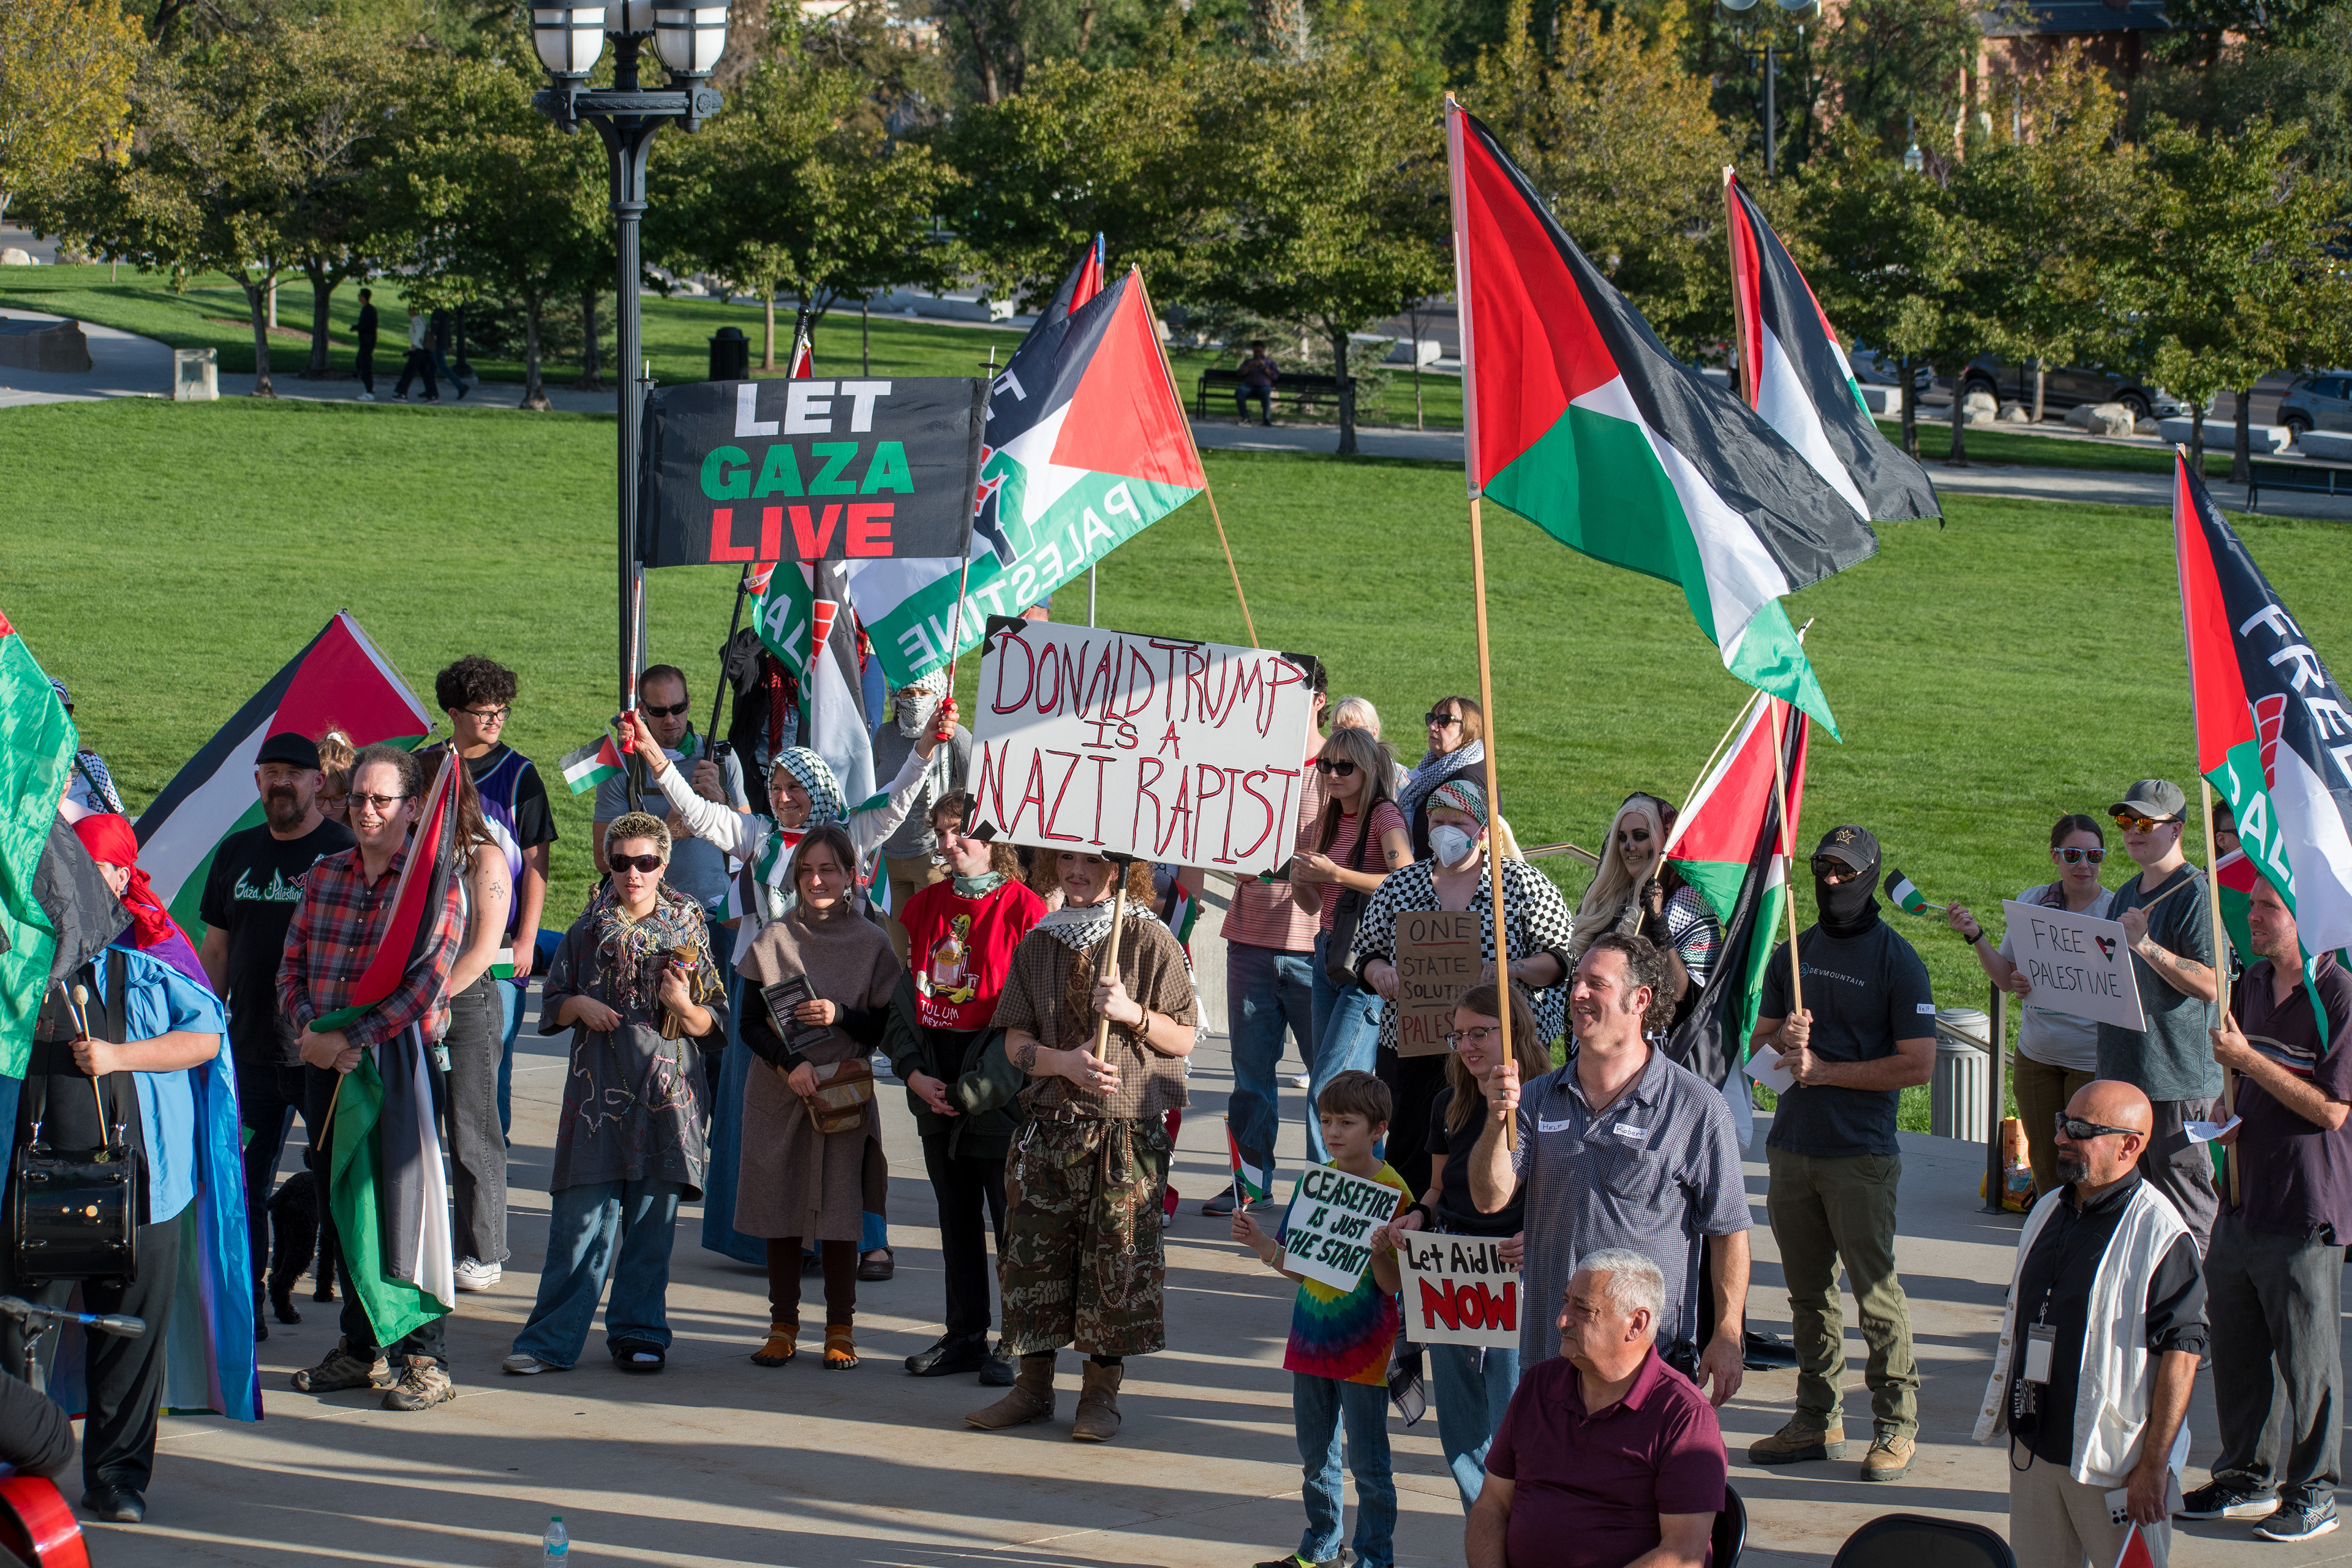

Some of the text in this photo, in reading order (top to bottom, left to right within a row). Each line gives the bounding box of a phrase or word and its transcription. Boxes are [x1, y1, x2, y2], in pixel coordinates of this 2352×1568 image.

[735, 381, 892, 437] LET
[701, 442, 914, 500] GAZA
[709, 503, 894, 561] LIVE
[991, 631, 1304, 739] DONALD TRUMP
[1082, 720, 1180, 760] IS A
[963, 739, 1300, 872] NAZI RAPIST
[1410, 916, 1471, 941] ONE
[2031, 918, 2086, 953] FREE
[1401, 956, 1469, 976] STATE
[1809, 968, 1864, 987] DEVMOUNTAIN
[2029, 959, 2121, 997] PALESTINE
[921, 1000, 959, 1020] TULUM
[1616, 1125, 1645, 1137] Robert
[1303, 1170, 1399, 1221] CEASEFIRE
[1306, 1205, 1372, 1240] IS JUST
[1287, 1227, 1373, 1276] THE START
[1406, 1238, 1444, 1273] Let
[1451, 1243, 1488, 1274] Aid
[1419, 1276, 1517, 1332] NOW
